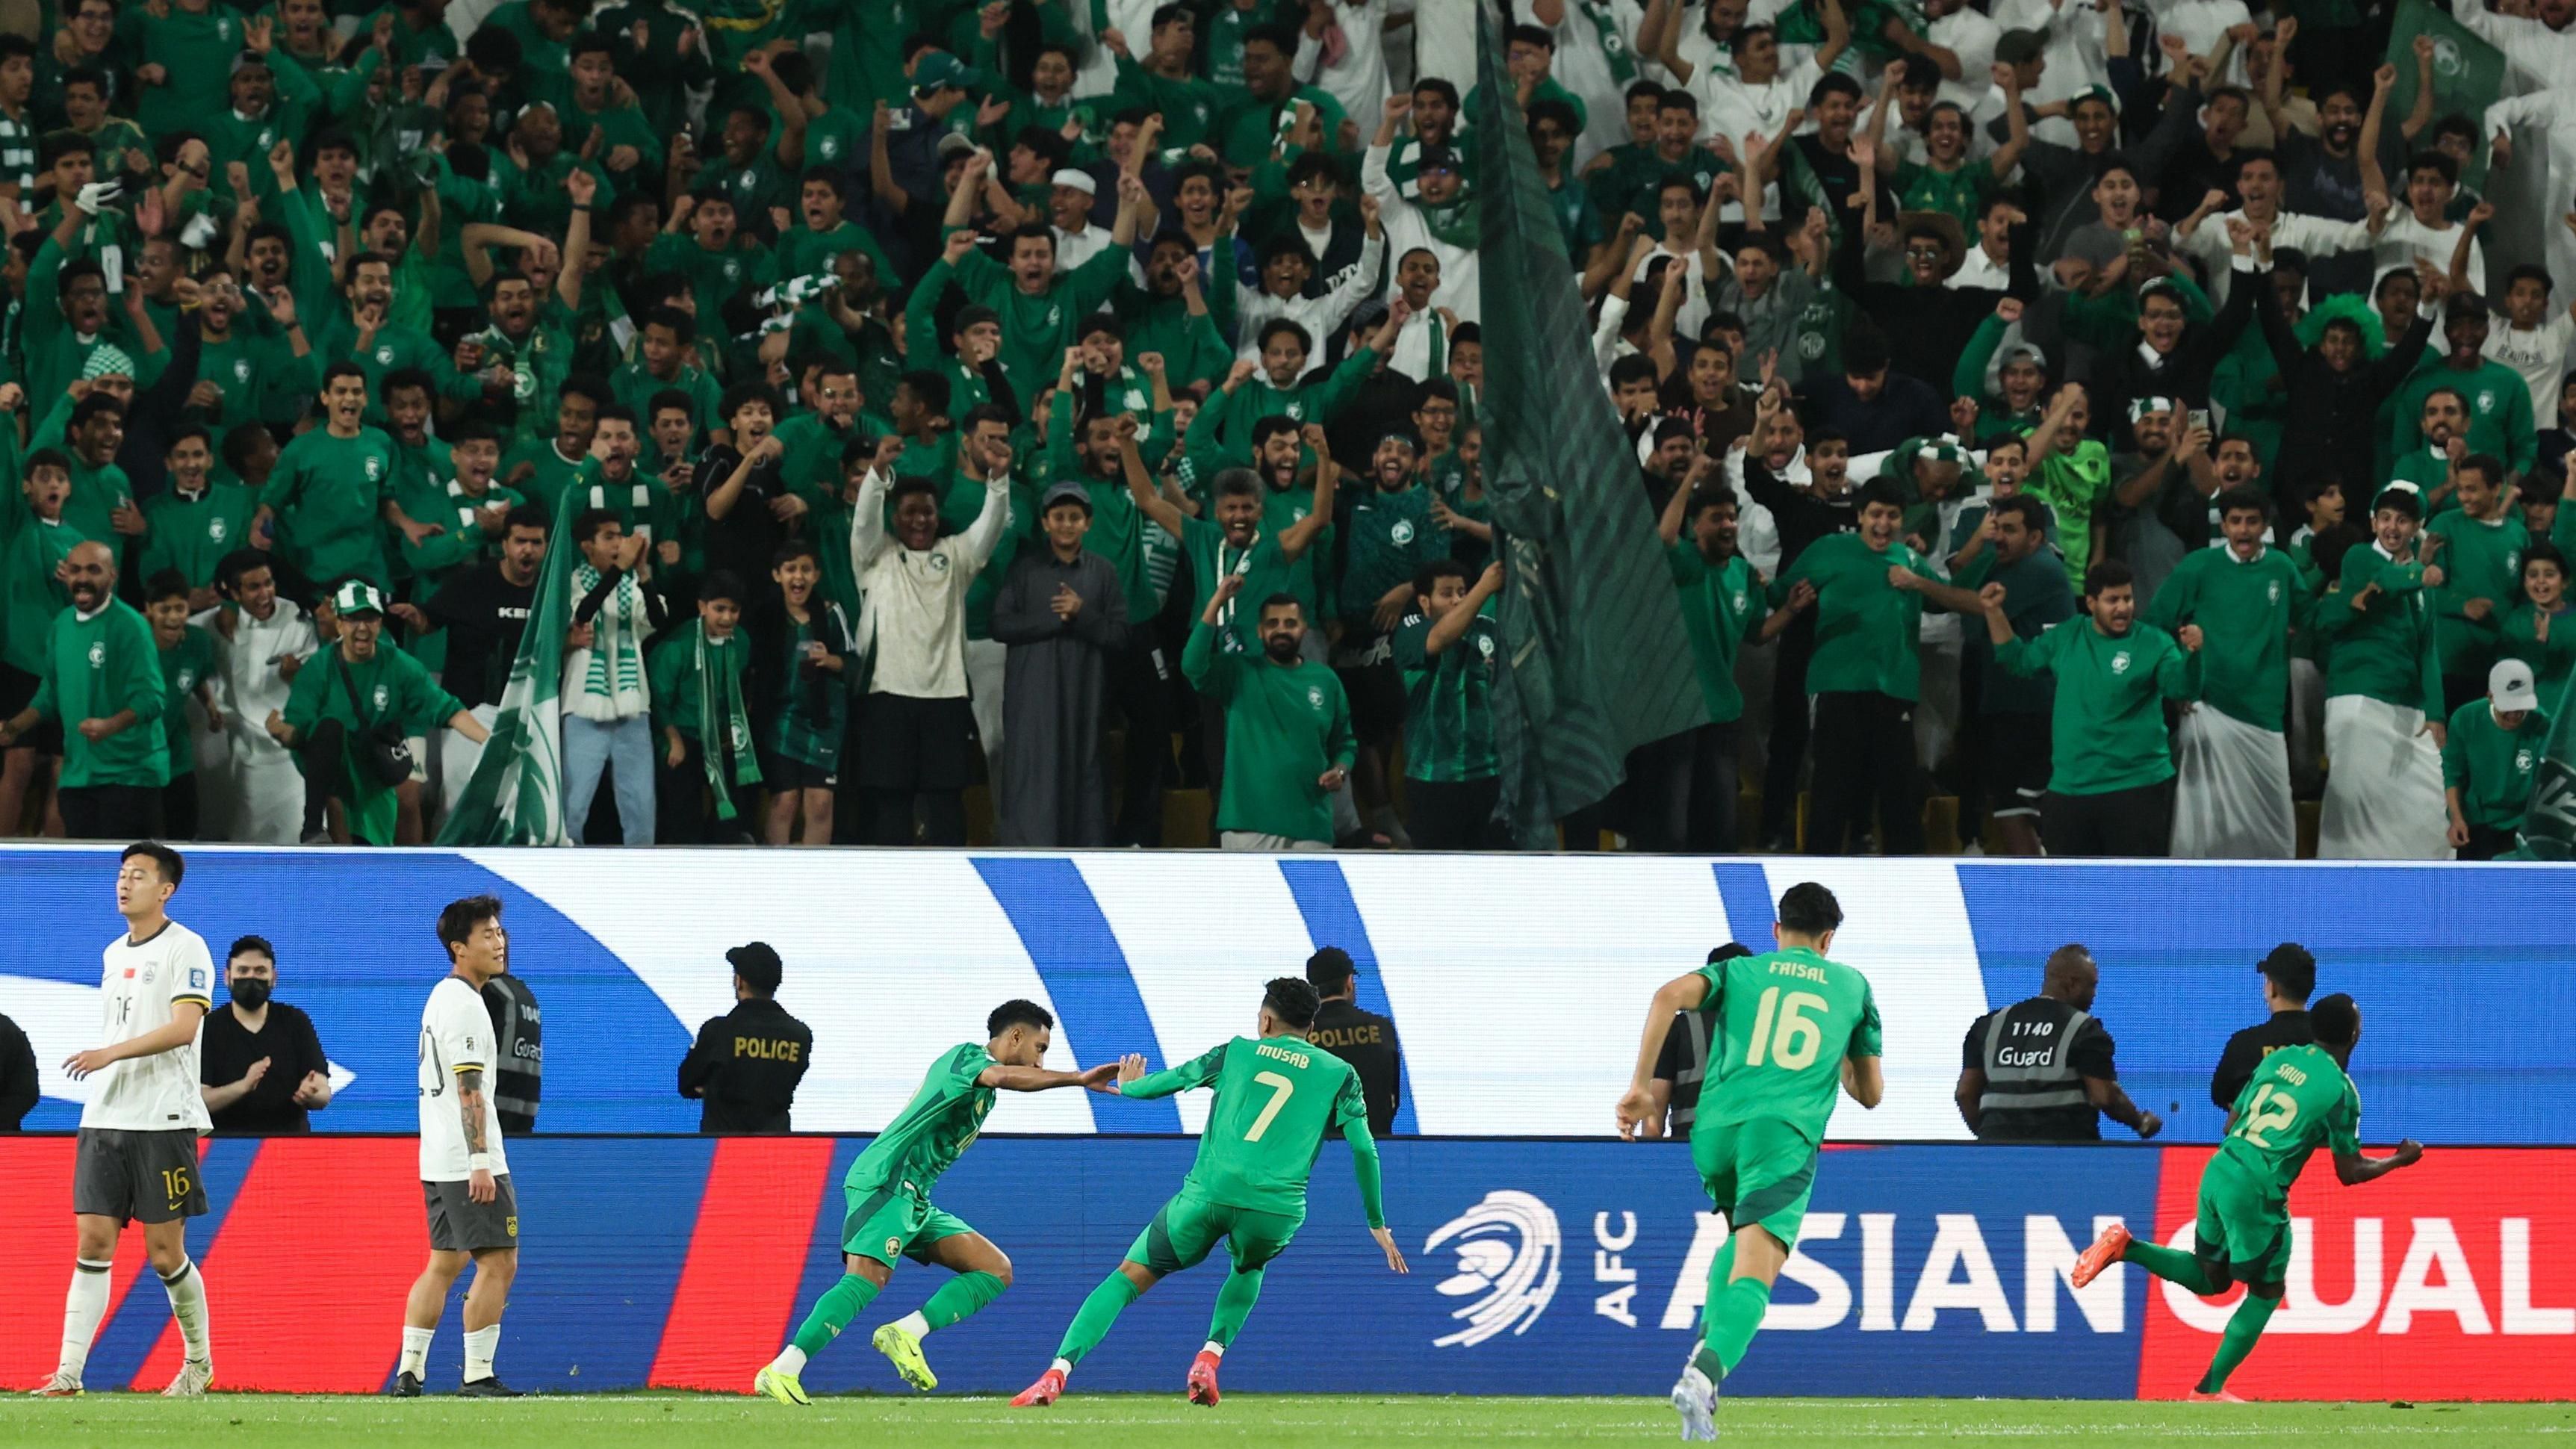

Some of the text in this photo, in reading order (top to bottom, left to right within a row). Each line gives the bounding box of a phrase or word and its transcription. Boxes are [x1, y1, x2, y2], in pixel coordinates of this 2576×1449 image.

[1769, 961, 1828, 984] FAISAL
[1309, 1026, 1382, 1047] POLICE
[1746, 986, 1829, 1071] 16
[2012, 1022, 2053, 1036] 1140
[735, 1037, 801, 1062] POLICE
[1256, 1044, 1309, 1069] MUSAB
[1999, 1046, 2053, 1067] Guard
[1244, 1071, 1294, 1142] 7
[2234, 1083, 2297, 1148] 12
[161, 1167, 190, 1200] 16
[1594, 1211, 1637, 1329] AFC
[1660, 1211, 2126, 1332] ASIAN
